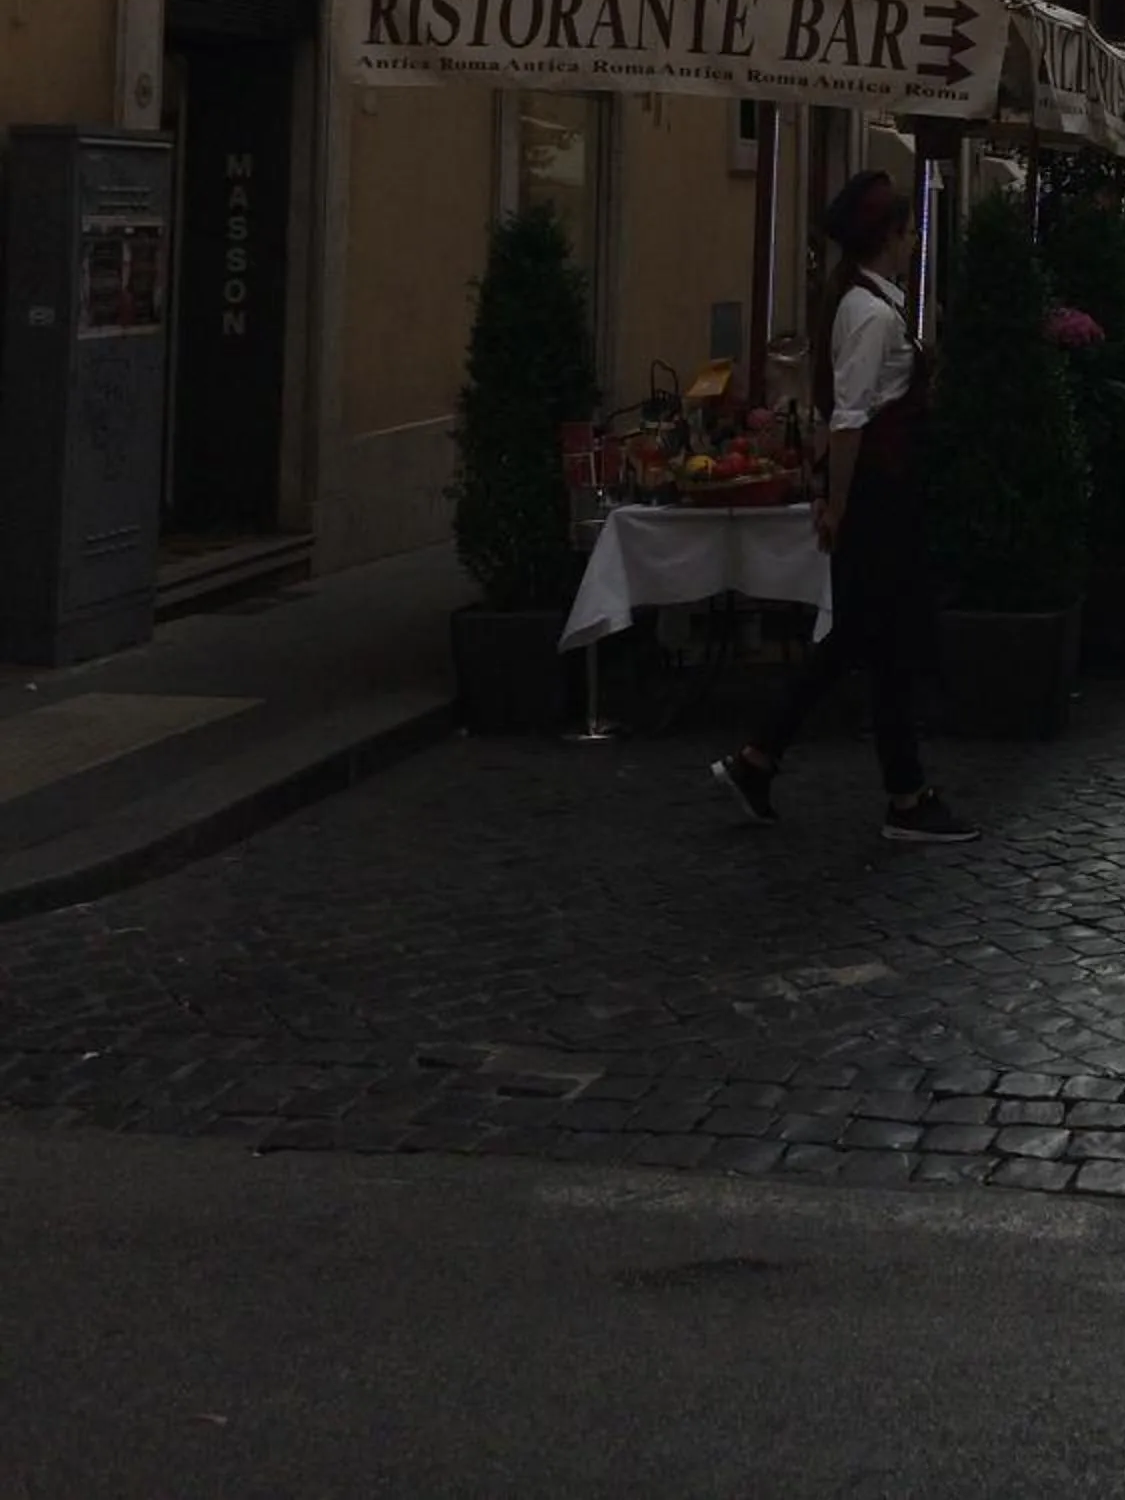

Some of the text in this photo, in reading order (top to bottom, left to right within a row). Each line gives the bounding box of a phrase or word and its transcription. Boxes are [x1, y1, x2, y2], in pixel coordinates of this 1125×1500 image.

[358, 55, 970, 101] Antica Roma Antica Roma Antica Roma Antica Roma
[221, 153, 255, 337] MASSON
